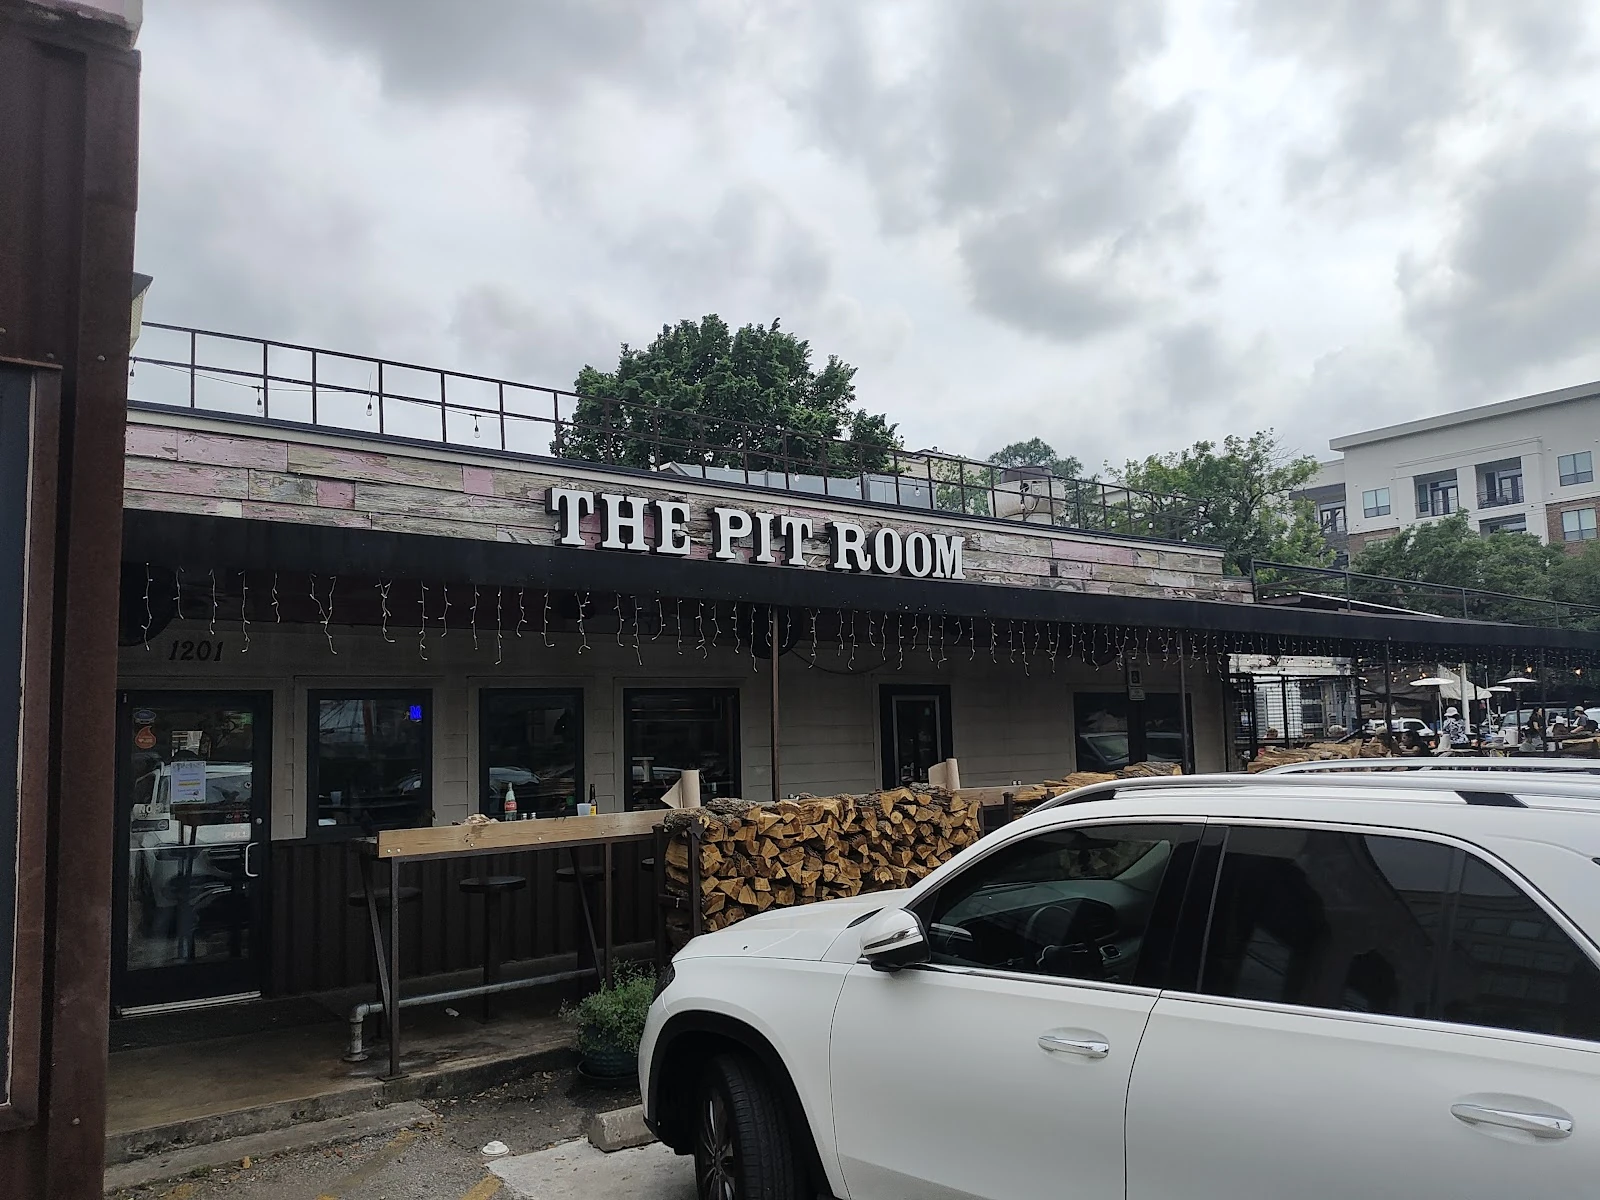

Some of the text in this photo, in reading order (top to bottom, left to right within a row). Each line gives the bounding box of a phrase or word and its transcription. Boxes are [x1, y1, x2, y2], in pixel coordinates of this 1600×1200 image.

[547, 487, 967, 582] THE PIT ROOM
[168, 640, 224, 661] 1201
